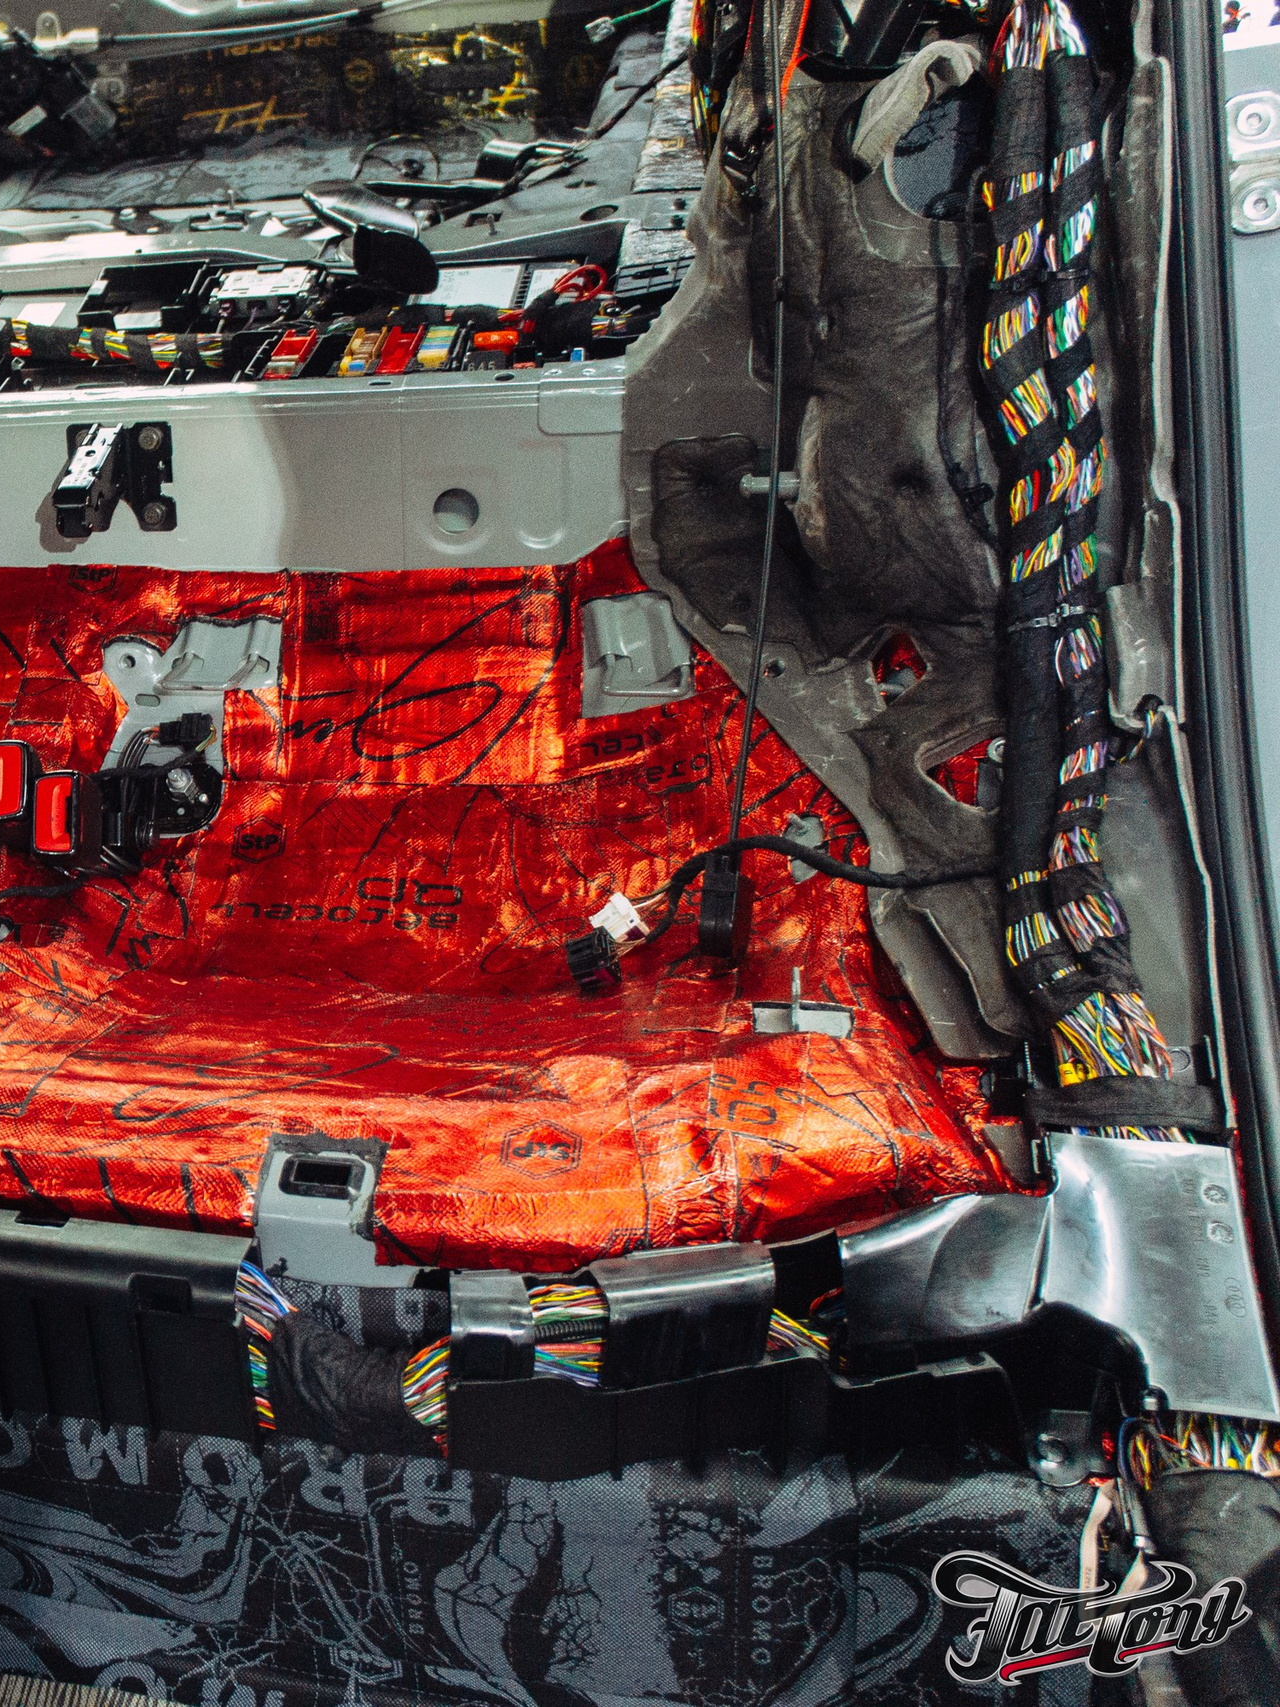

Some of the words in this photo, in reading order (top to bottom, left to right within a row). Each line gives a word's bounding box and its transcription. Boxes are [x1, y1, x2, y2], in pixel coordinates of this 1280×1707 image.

[75, 566, 112, 582] StP
[239, 833, 279, 850] StP
[209, 902, 461, 931] aerocell
[512, 1140, 572, 1162] StP
[402, 1561, 424, 1635] BROMO
[751, 1555, 774, 1665] BROMO
